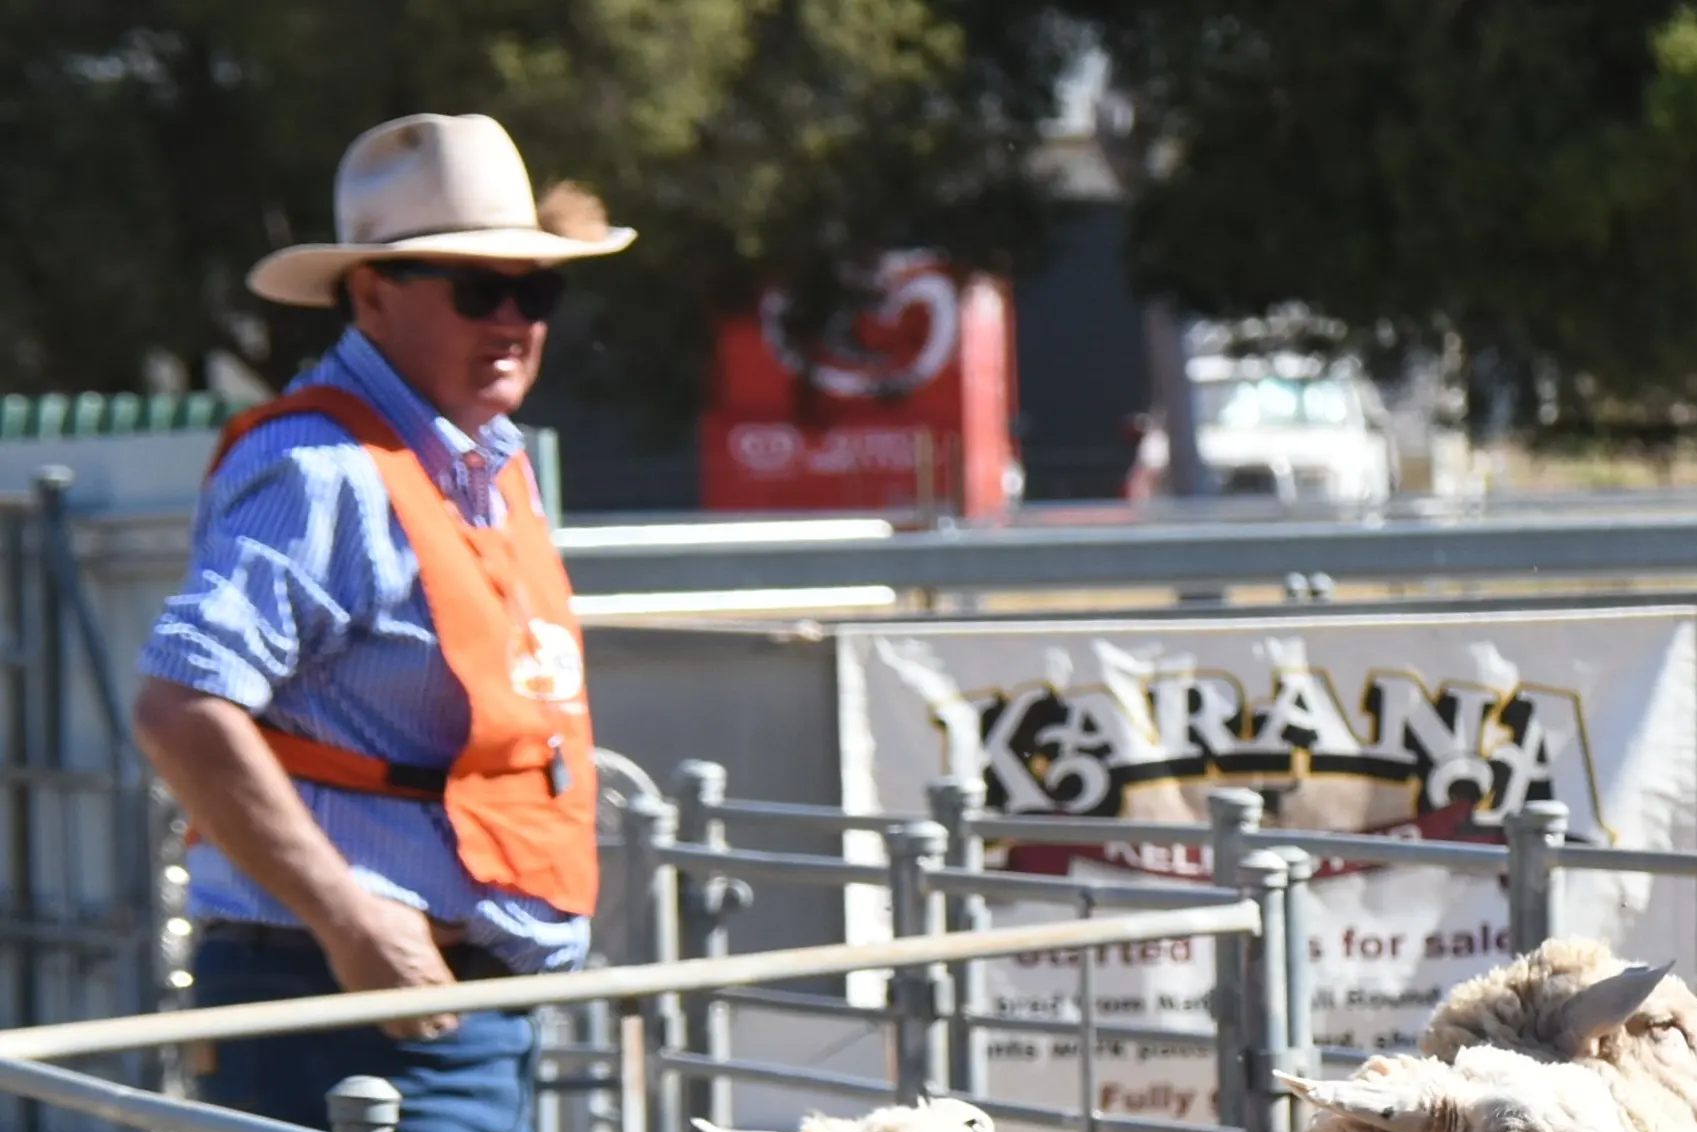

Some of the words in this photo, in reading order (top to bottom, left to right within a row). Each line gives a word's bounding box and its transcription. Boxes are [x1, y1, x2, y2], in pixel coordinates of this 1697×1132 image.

[932, 670, 1618, 846] KARANA
[1343, 926, 1406, 960] for
[1101, 1082, 1199, 1117] Fully
